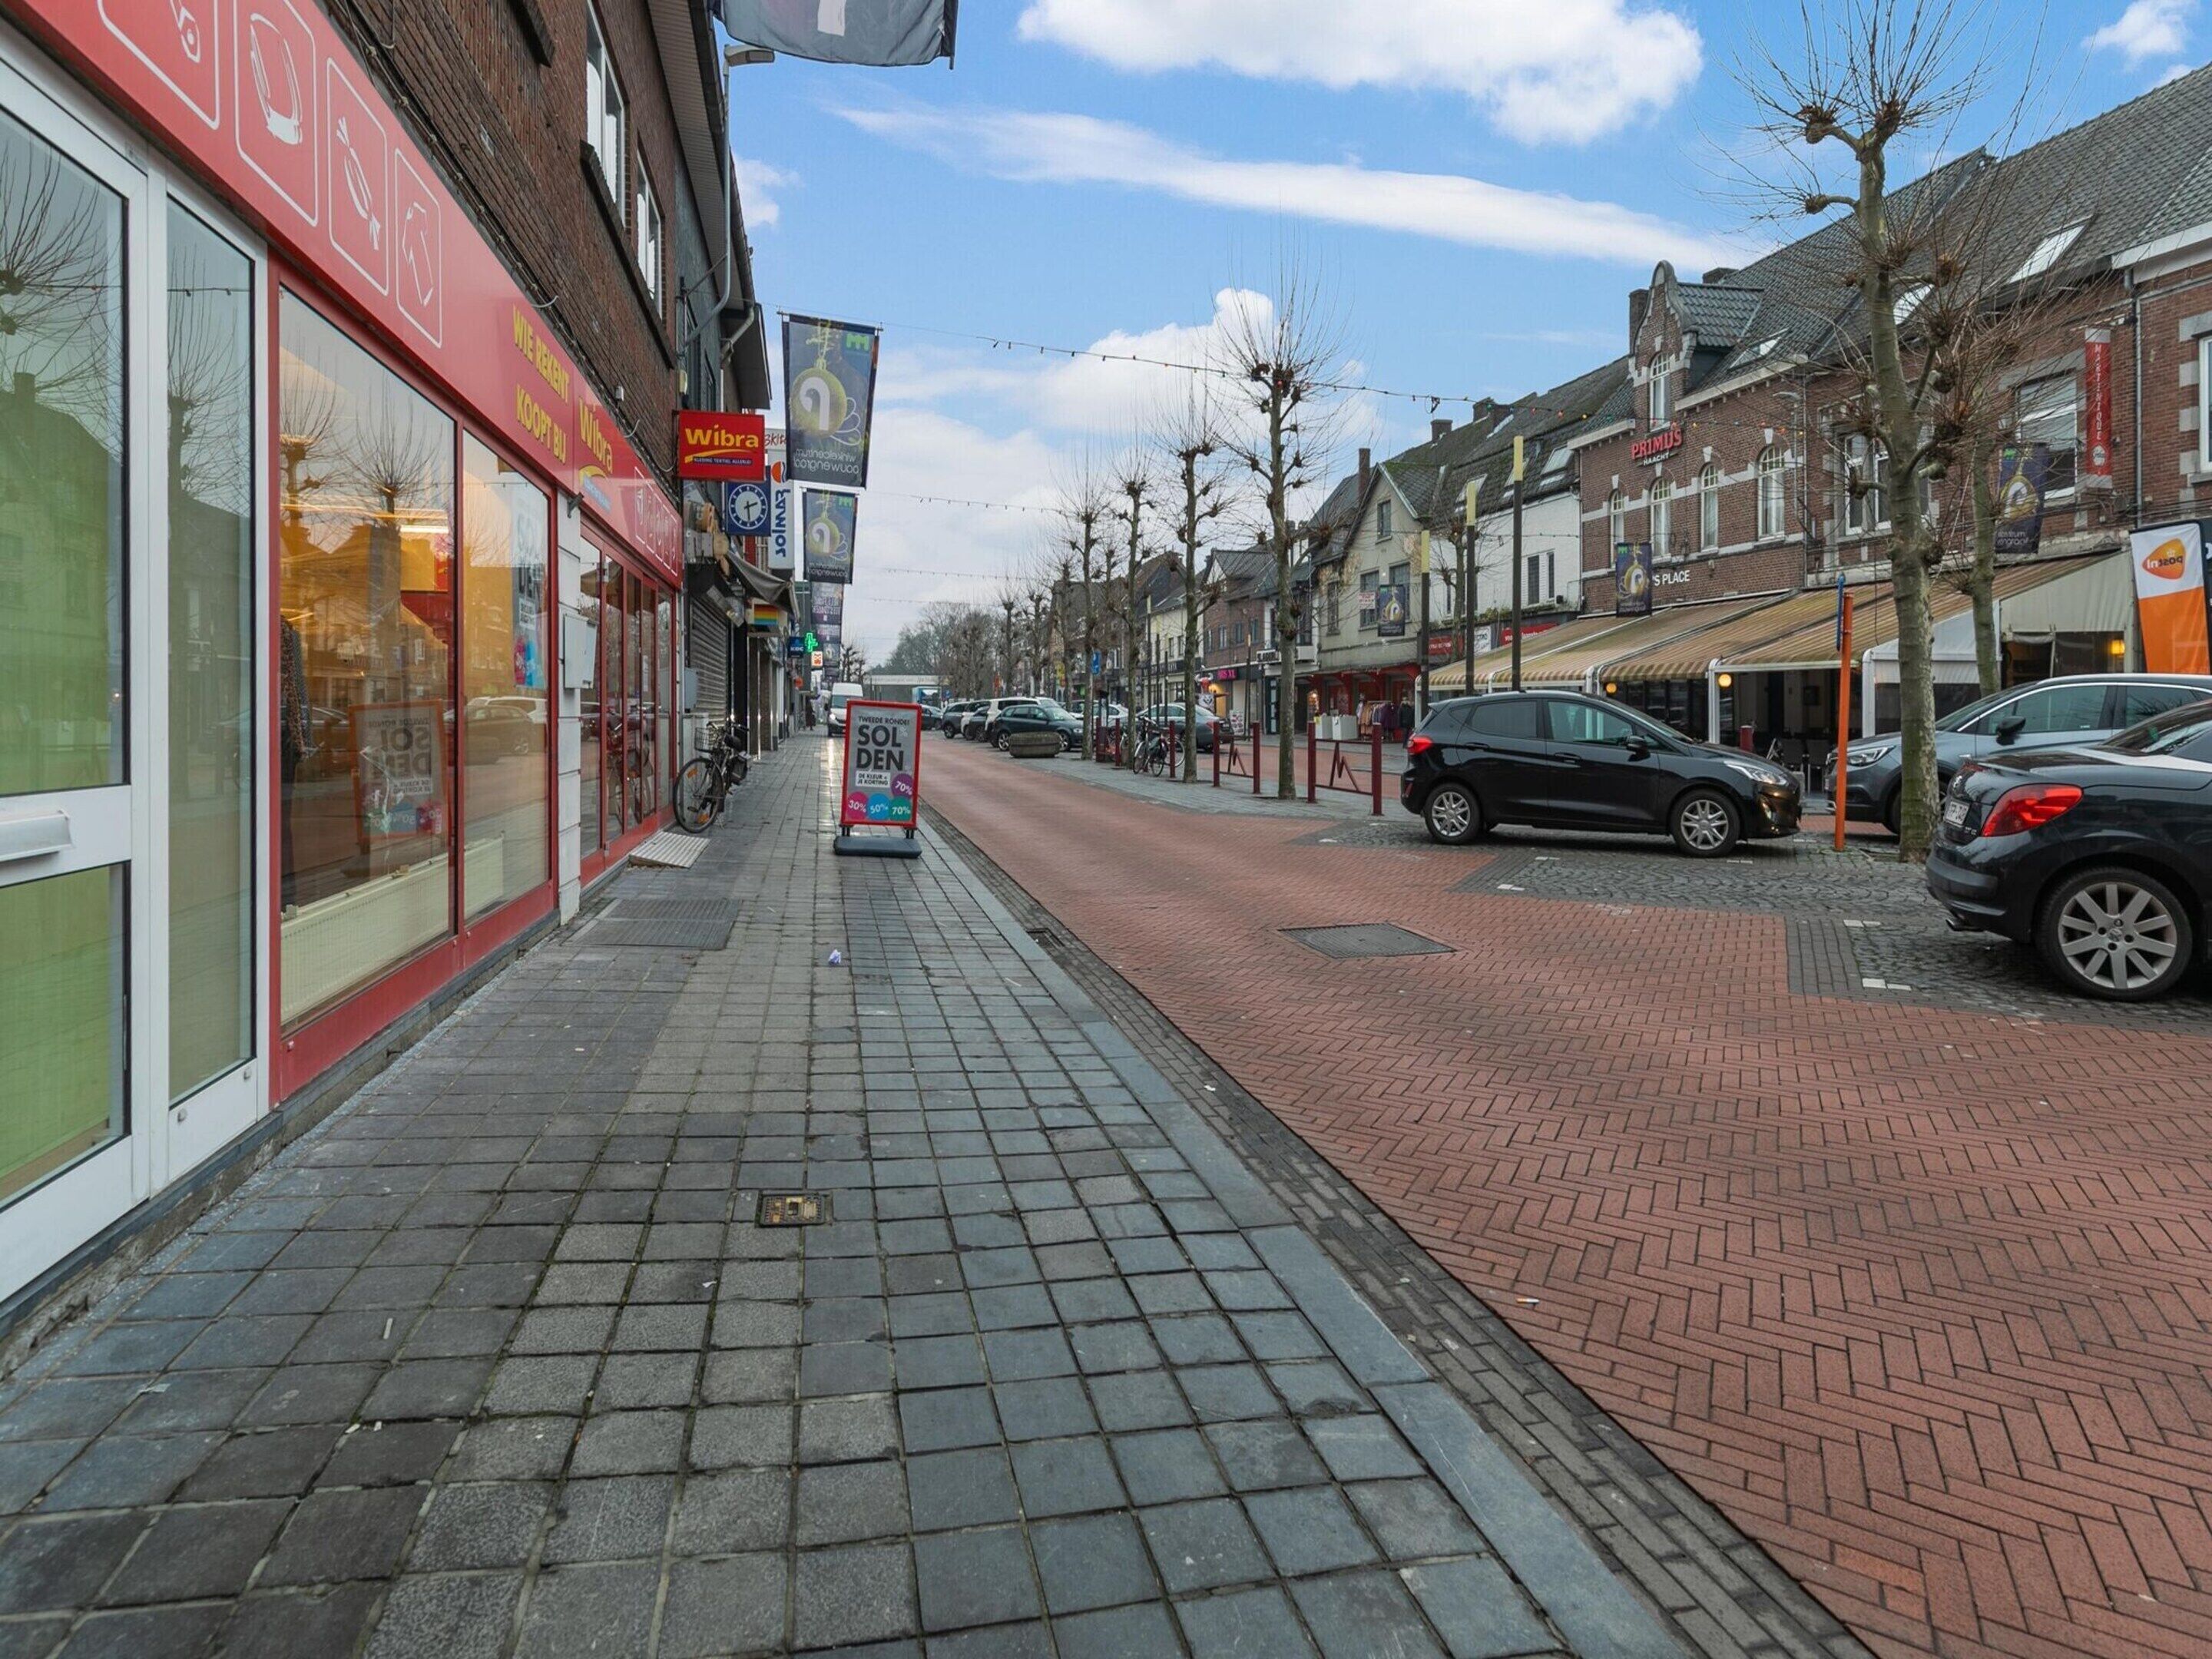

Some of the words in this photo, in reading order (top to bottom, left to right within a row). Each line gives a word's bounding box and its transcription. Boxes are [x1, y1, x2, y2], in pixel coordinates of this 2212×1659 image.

[513, 303, 534, 363] WIE
[536, 333, 569, 403] REKENT
[516, 384, 551, 449] KOOPT
[552, 427, 566, 465] BIJ
[579, 396, 613, 475] Wibra
[685, 424, 759, 447] Wibra
[1631, 429, 1683, 461] PRIMUS
[1643, 452, 1670, 465] HAACHT
[1662, 570, 1690, 585] PLACE
[859, 715, 882, 724] TWEEDE
[857, 724, 902, 747] SOL
[856, 747, 904, 771] DEN
[895, 780, 913, 795] 70%
[848, 800, 867, 813] 30%
[869, 803, 889, 814] 50%
[892, 806, 912, 815] 70%
